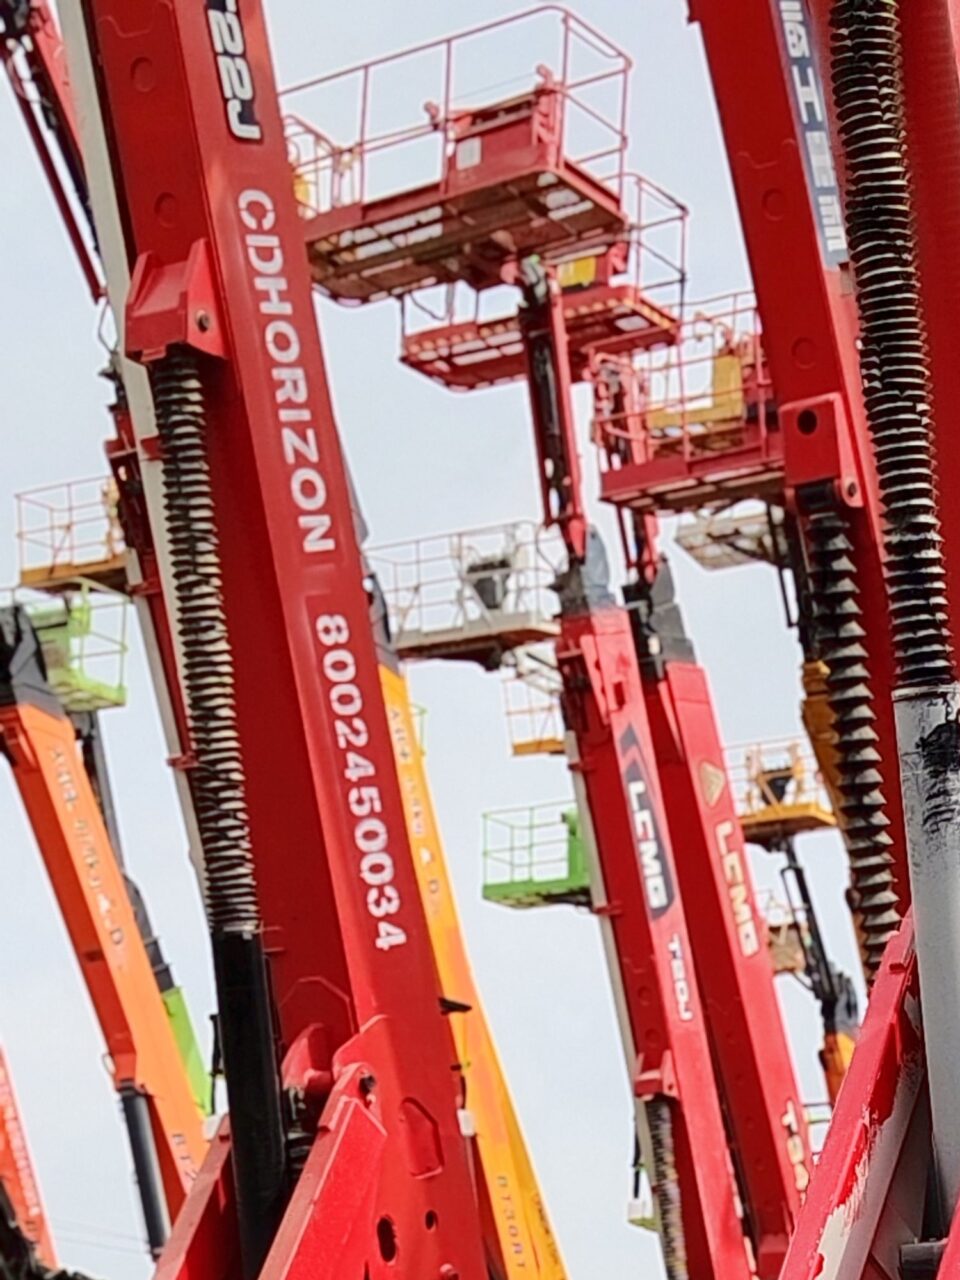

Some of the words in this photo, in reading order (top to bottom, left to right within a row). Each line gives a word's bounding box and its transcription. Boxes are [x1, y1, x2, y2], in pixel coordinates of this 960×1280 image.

[207, 0, 261, 140] 22J
[238, 189, 335, 554] CDHORIZON
[316, 614, 407, 950] 8002450034
